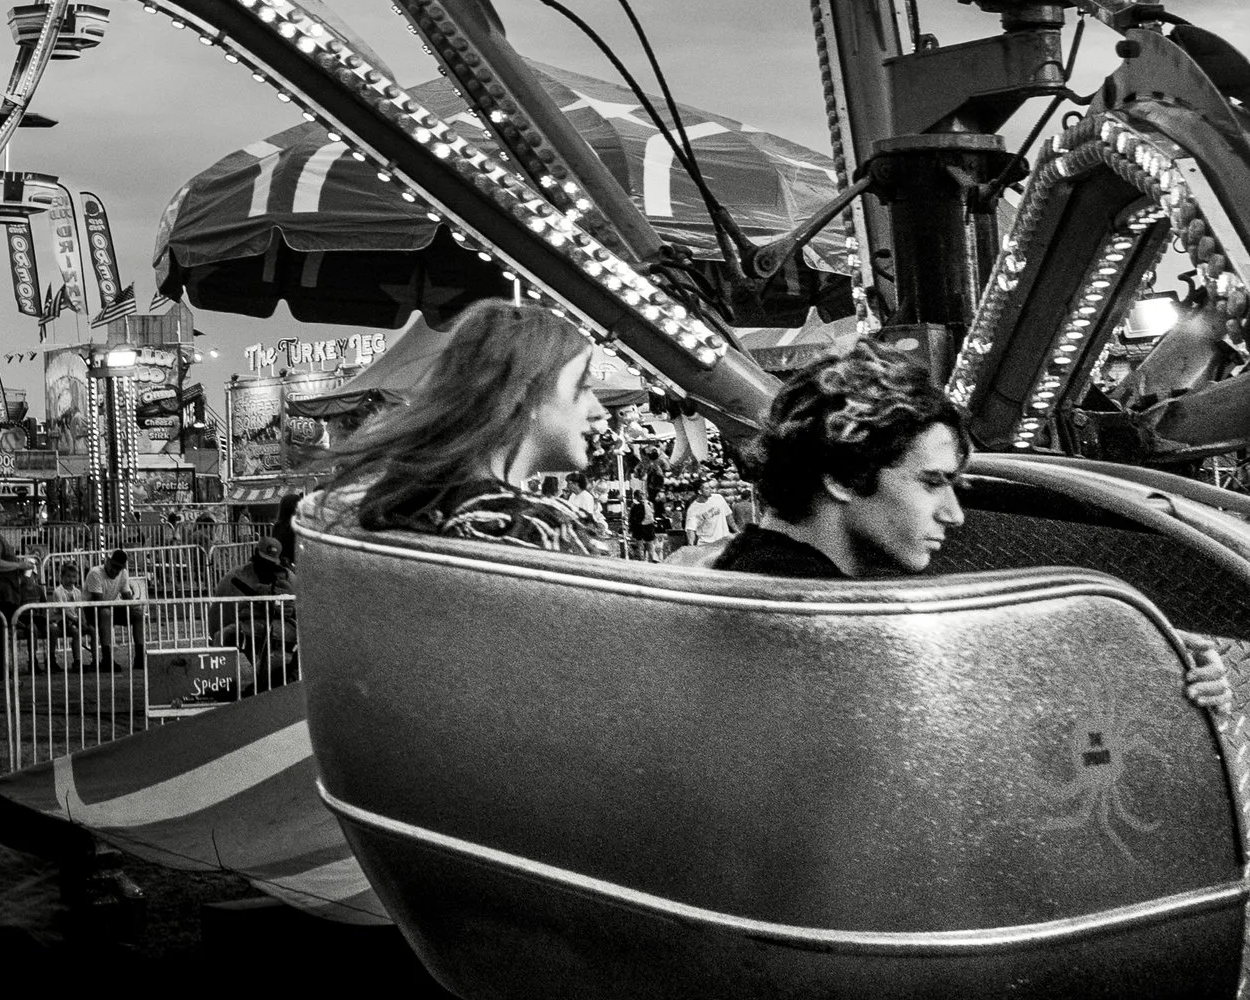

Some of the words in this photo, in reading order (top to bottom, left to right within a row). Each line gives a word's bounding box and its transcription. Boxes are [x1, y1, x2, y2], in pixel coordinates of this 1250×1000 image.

[244, 342, 277, 371] The
[278, 336, 348, 368] TURKEY
[349, 333, 386, 365] LEG
[144, 419, 173, 427] Cheese
[149, 432, 170, 440] Stick
[156, 481, 189, 491] Pretzels
[190, 676, 233, 696] Spider
